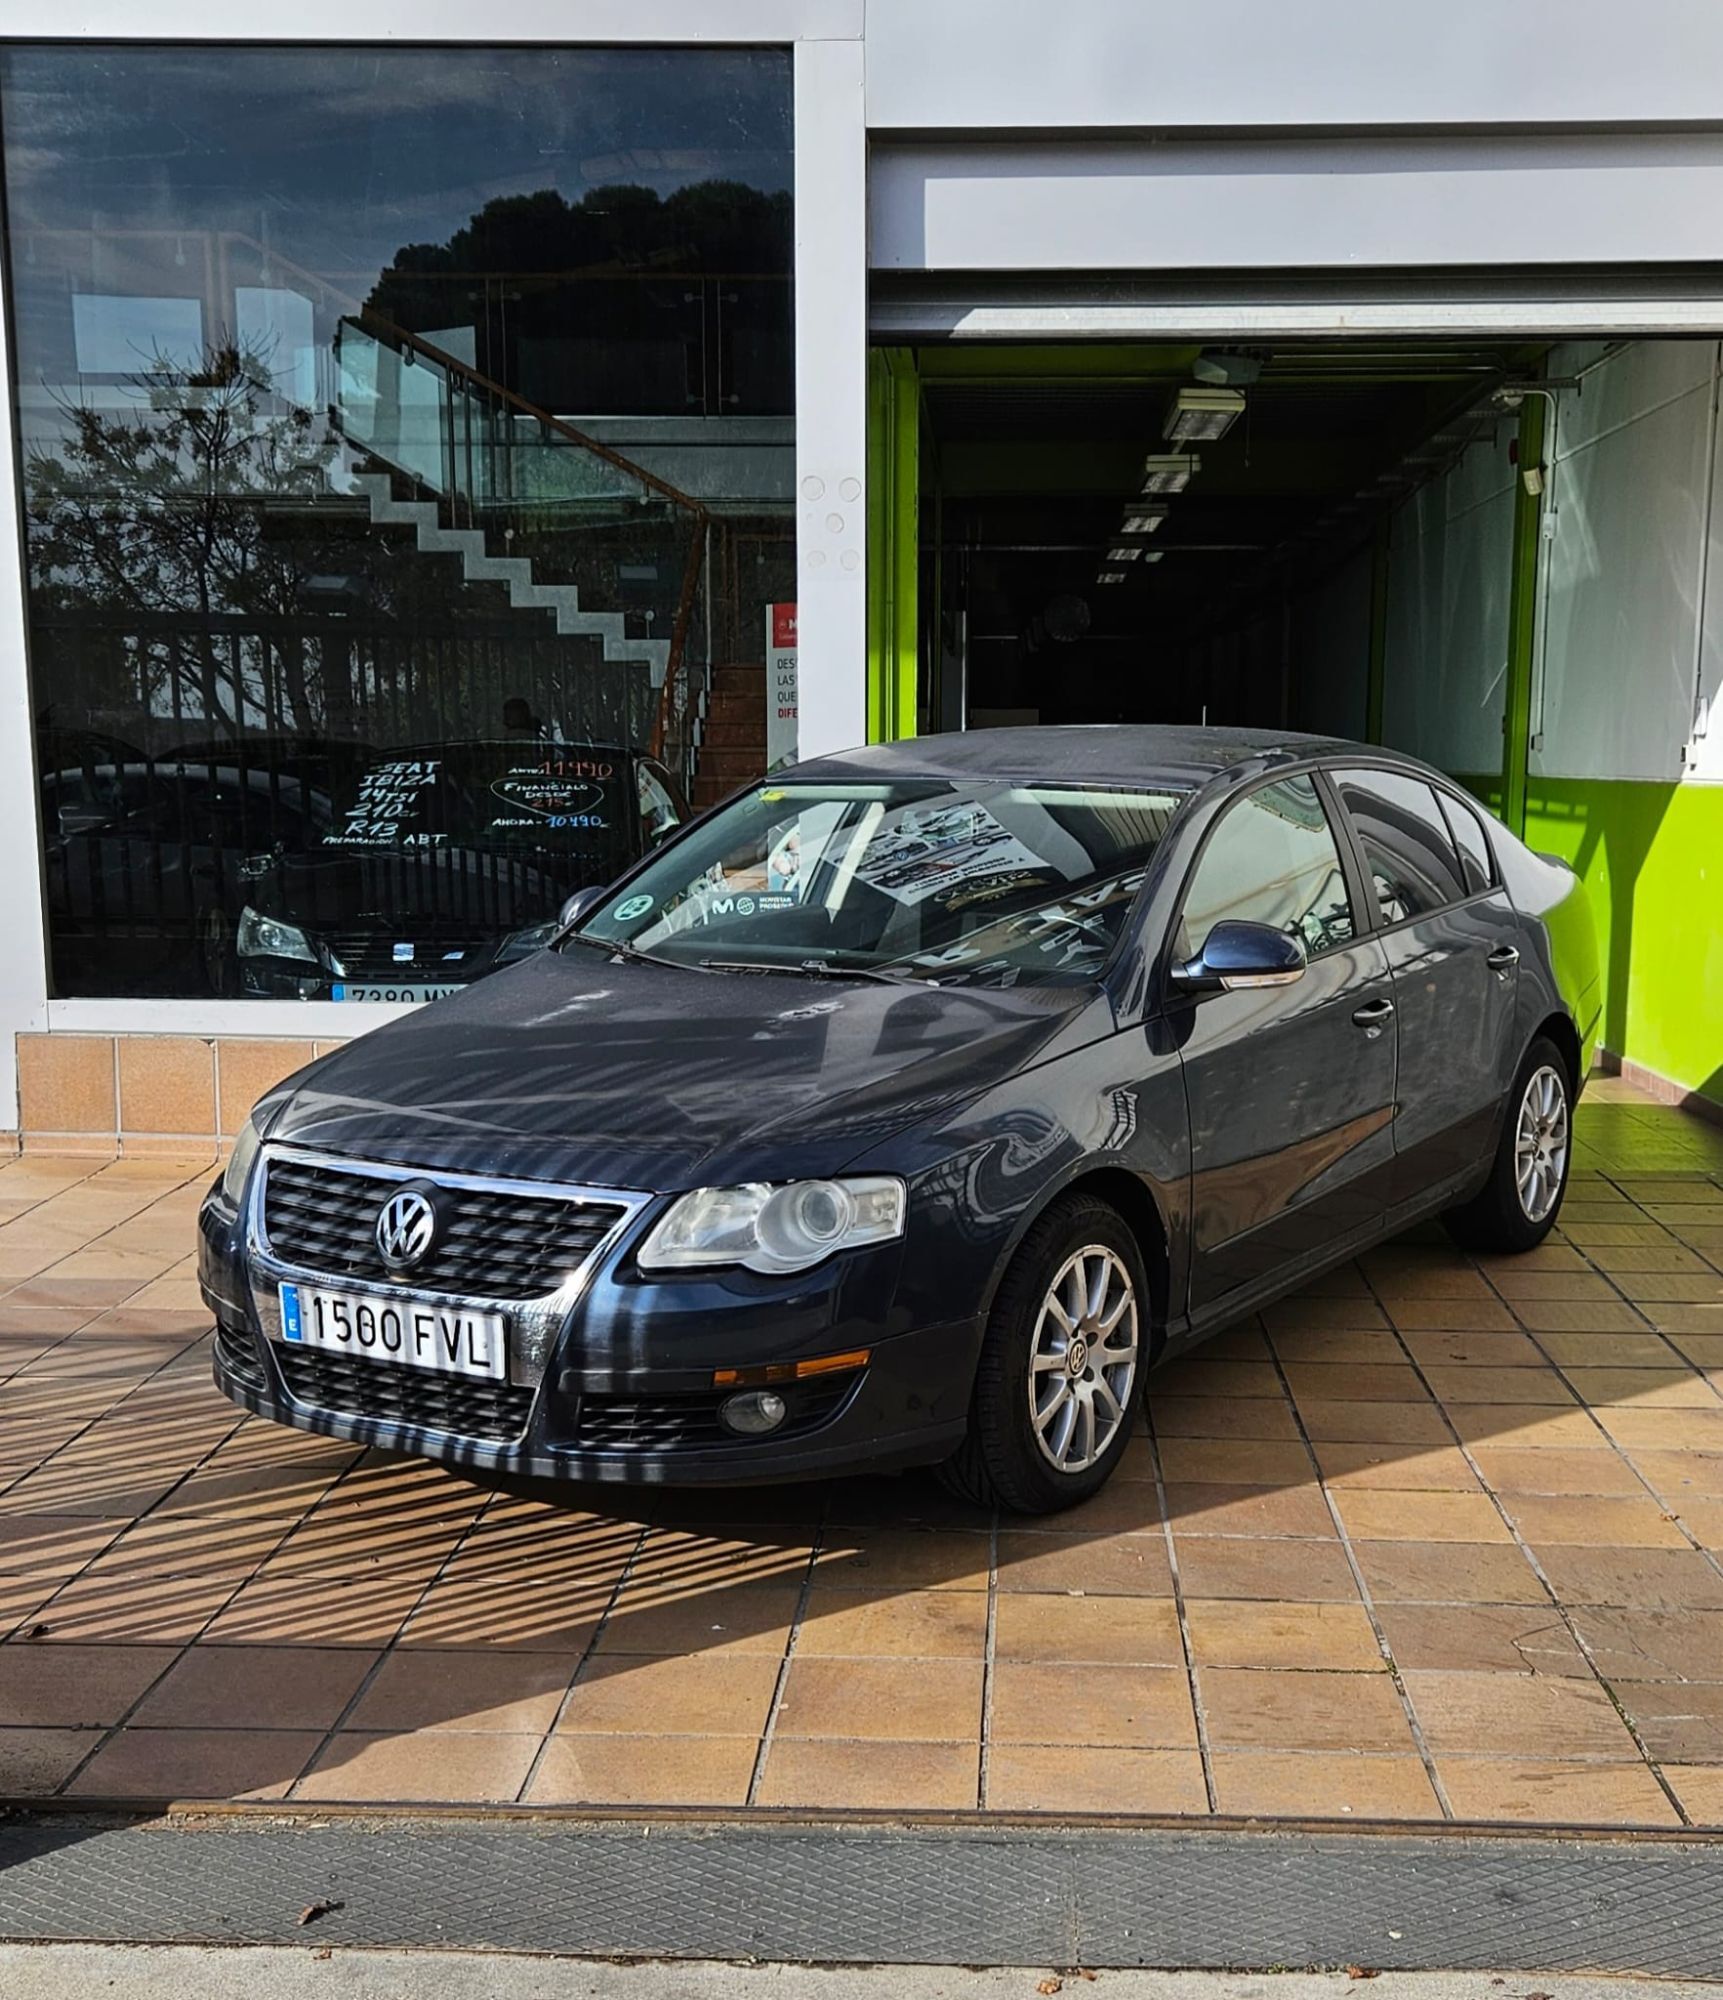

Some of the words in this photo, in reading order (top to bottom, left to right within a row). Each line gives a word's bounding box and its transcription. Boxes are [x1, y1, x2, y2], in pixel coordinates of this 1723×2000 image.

[378, 761, 441, 774] SEAT
[359, 774, 436, 787] IBIZA
[414, 1313, 491, 1368] FVL
